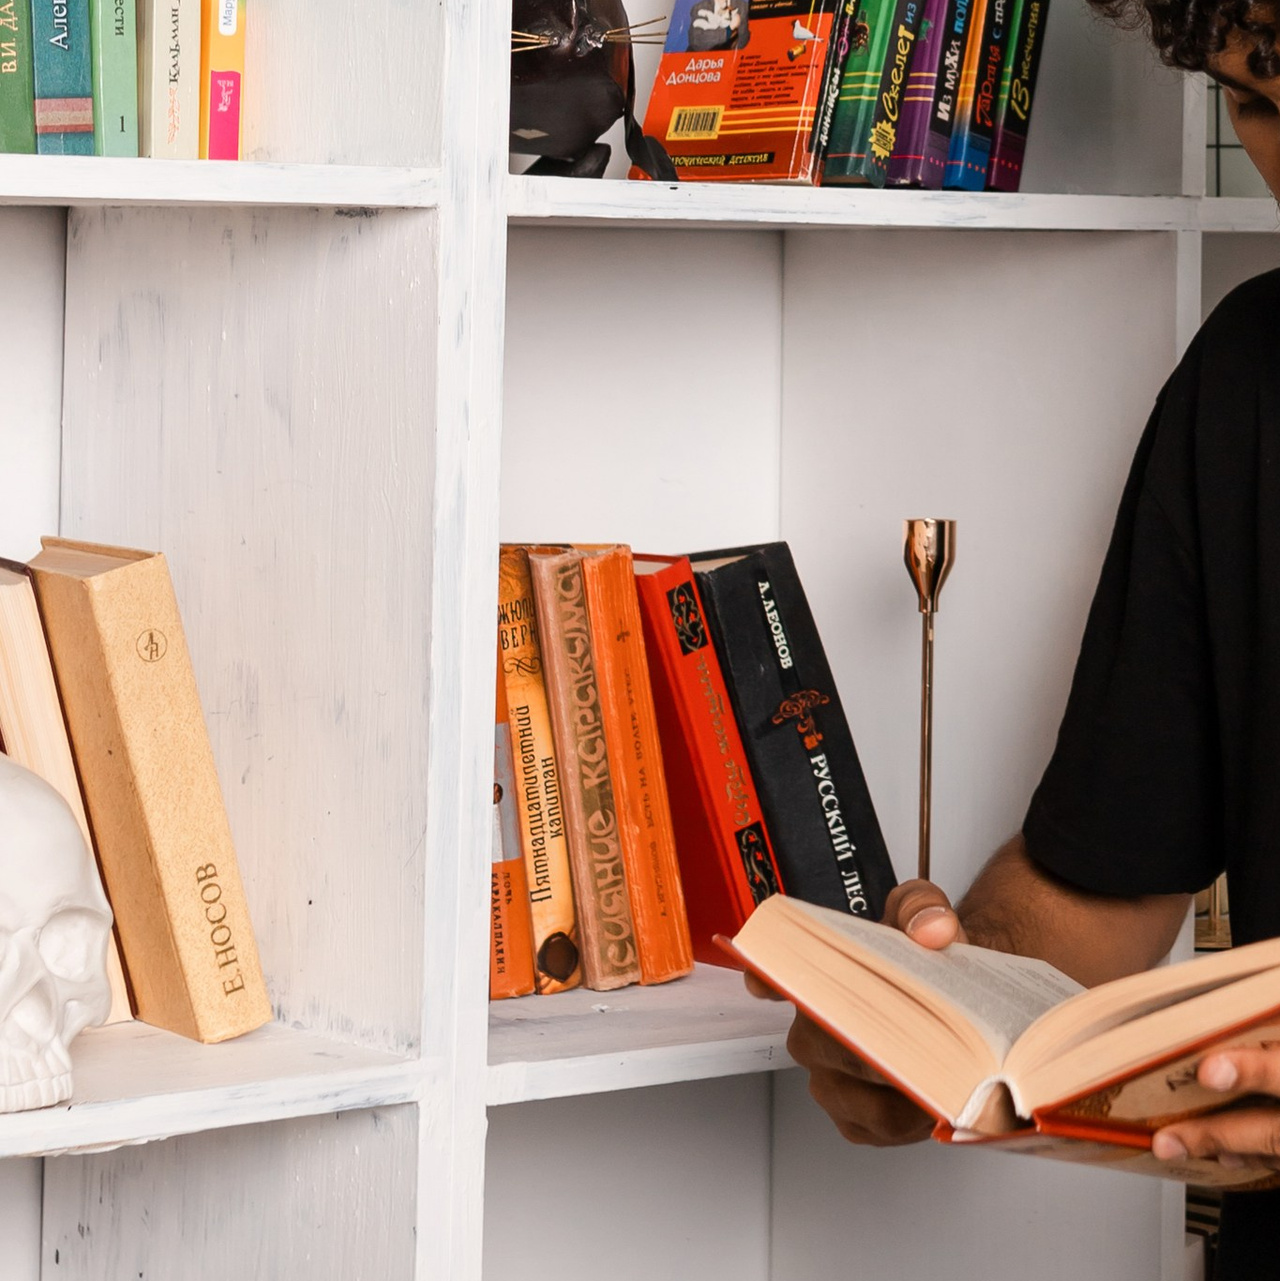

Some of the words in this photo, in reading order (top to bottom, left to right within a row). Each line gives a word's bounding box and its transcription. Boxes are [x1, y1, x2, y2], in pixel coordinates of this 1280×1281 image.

[666, 70, 721, 86] Донцова
[685, 58, 724, 73] Дарья
[882, 24, 916, 122] Скелет
[905, 2, 917, 25] из
[936, 95, 953, 122] Из
[945, 40, 961, 91] мухи
[630, 711, 644, 761] ВОЛГЕ
[510, 703, 553, 903] Пятнадцатилетний
[540, 756, 564, 840] капитан
[638, 767, 648, 789] НА
[810, 752, 857, 862] РУССКИЙ
[841, 868, 867, 915] ЛЕС
